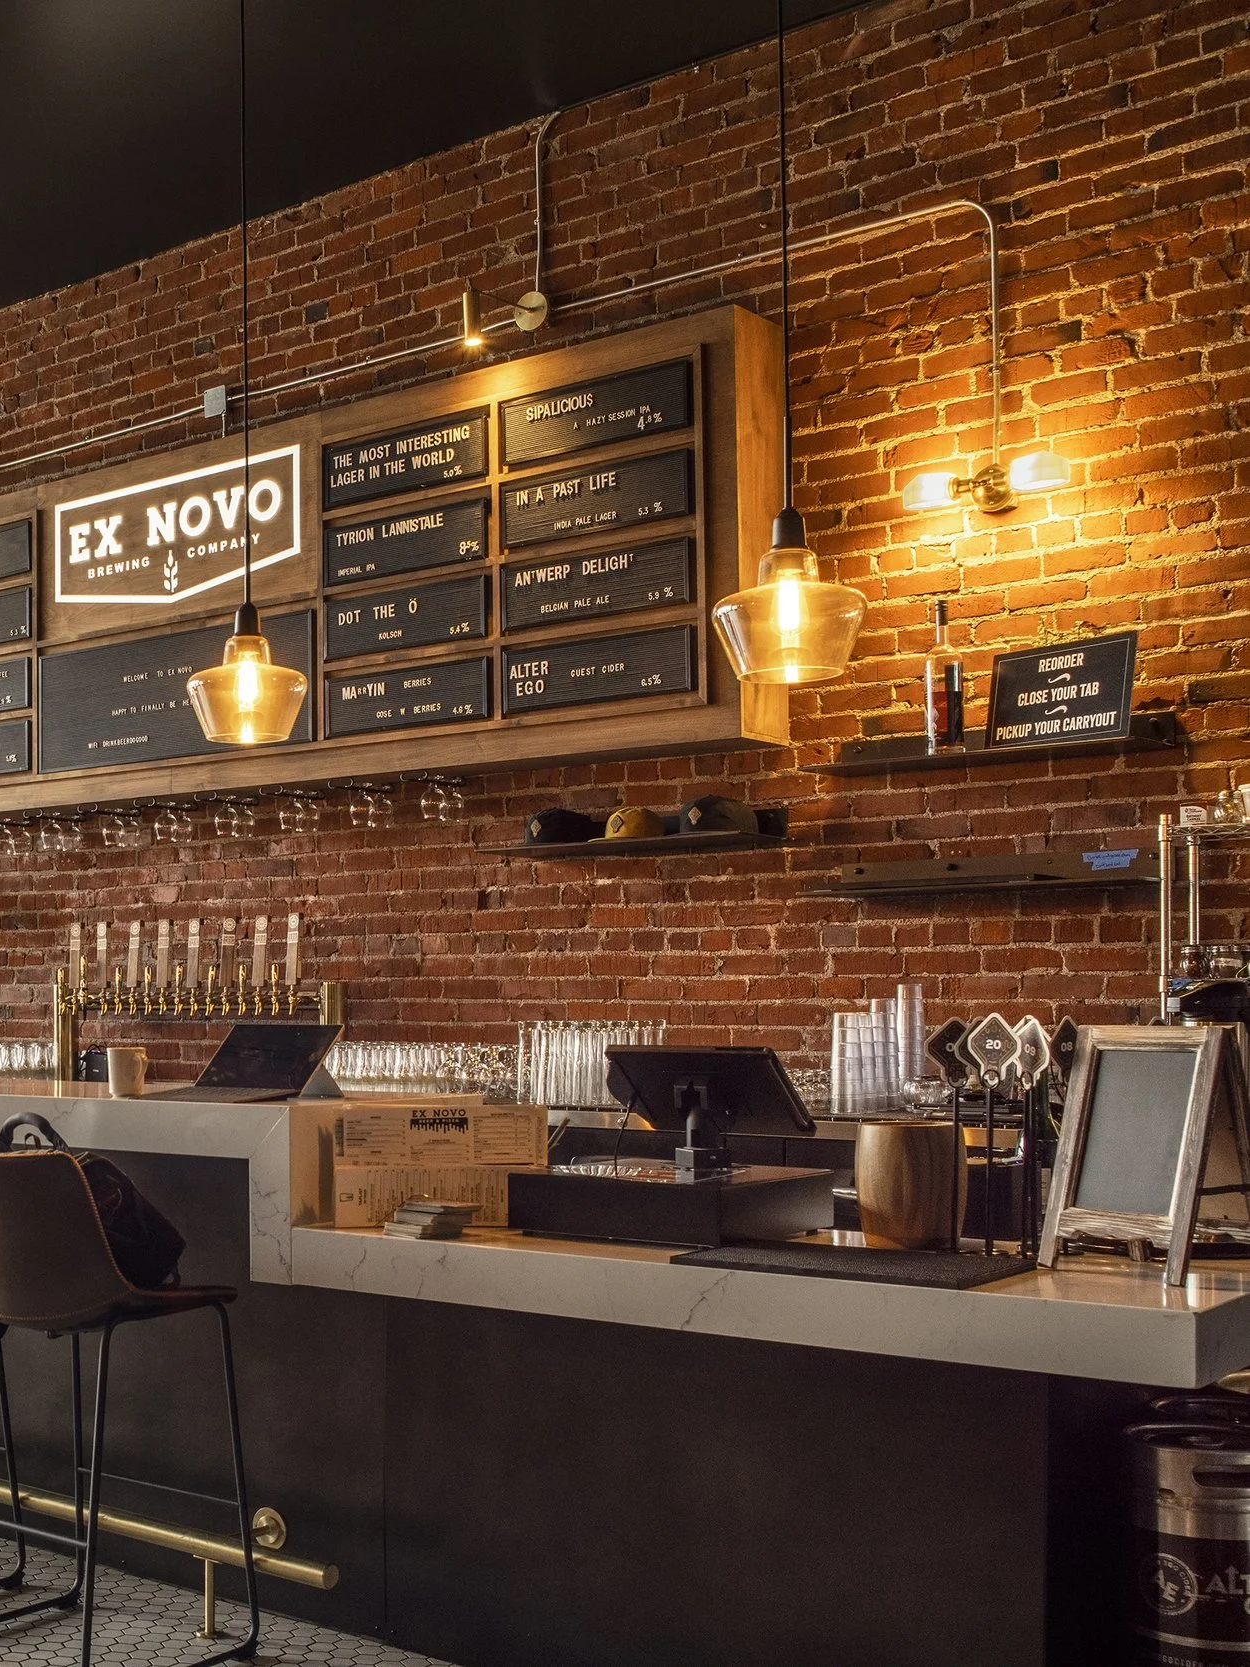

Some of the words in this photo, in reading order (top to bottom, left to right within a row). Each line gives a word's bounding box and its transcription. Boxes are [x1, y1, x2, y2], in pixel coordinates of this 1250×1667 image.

[573, 422, 579, 430] A
[586, 415, 606, 427] HAZY
[608, 408, 636, 422] SESSION
[639, 405, 650, 415] IPA
[333, 453, 353, 469] THE
[359, 444, 391, 464] MOST
[396, 425, 470, 455] INTERESTING
[330, 468, 365, 488] LAGER
[369, 465, 380, 479] IN
[384, 459, 406, 475] THE
[411, 448, 455, 469] WORLD
[516, 490, 529, 506] IN
[535, 488, 544, 502] A
[589, 472, 616, 491] LIFE
[69, 515, 123, 564] EX
[146, 479, 282, 547] NOVO
[336, 527, 374, 547] TYRION
[382, 513, 444, 538] LANNISTALE
[554, 521, 572, 531] INDIA
[575, 515, 591, 526] PALE
[595, 511, 617, 522] LAGER
[87, 556, 150, 579] BREWING
[337, 564, 362, 577] IMPERIAL
[366, 563, 375, 571] IPA
[515, 564, 570, 587] ANTWERP
[582, 553, 634, 576] DELIGHT
[338, 610, 361, 626] DOT
[373, 603, 395, 620] THE
[540, 602, 569, 614] BELGIAN
[574, 598, 591, 608] PALE
[596, 595, 610, 604] ALE
[378, 629, 402, 640] KOLSCH
[510, 660, 549, 680] ALTER
[570, 667, 596, 677] GUEST
[602, 663, 625, 674] CIDER
[1038, 652, 1084, 673] REORDER
[123, 673, 148, 682] WELCOME
[177, 666, 193, 674] NOVO
[403, 677, 432, 689] BERRIES
[516, 679, 545, 697] EGO
[1018, 690, 1049, 707] CLOSE
[1051, 685, 1077, 702] YOUR
[1079, 682, 1100, 697] TAB
[112, 708, 127, 716] HAPPY
[141, 703, 165, 712] FINALLY
[413, 703, 441, 714] BERRIES
[996, 724, 1032, 741] PICKUP
[1035, 719, 1061, 735] YOUR
[1063, 711, 1117, 732] CARRYOUT
[986, 1039, 1001, 1050] 20
[1025, 1043, 1036, 1056] 09
[1061, 1042, 1073, 1051] 08
[412, 1110, 427, 1118] EX
[433, 1109, 466, 1118] NOVO
